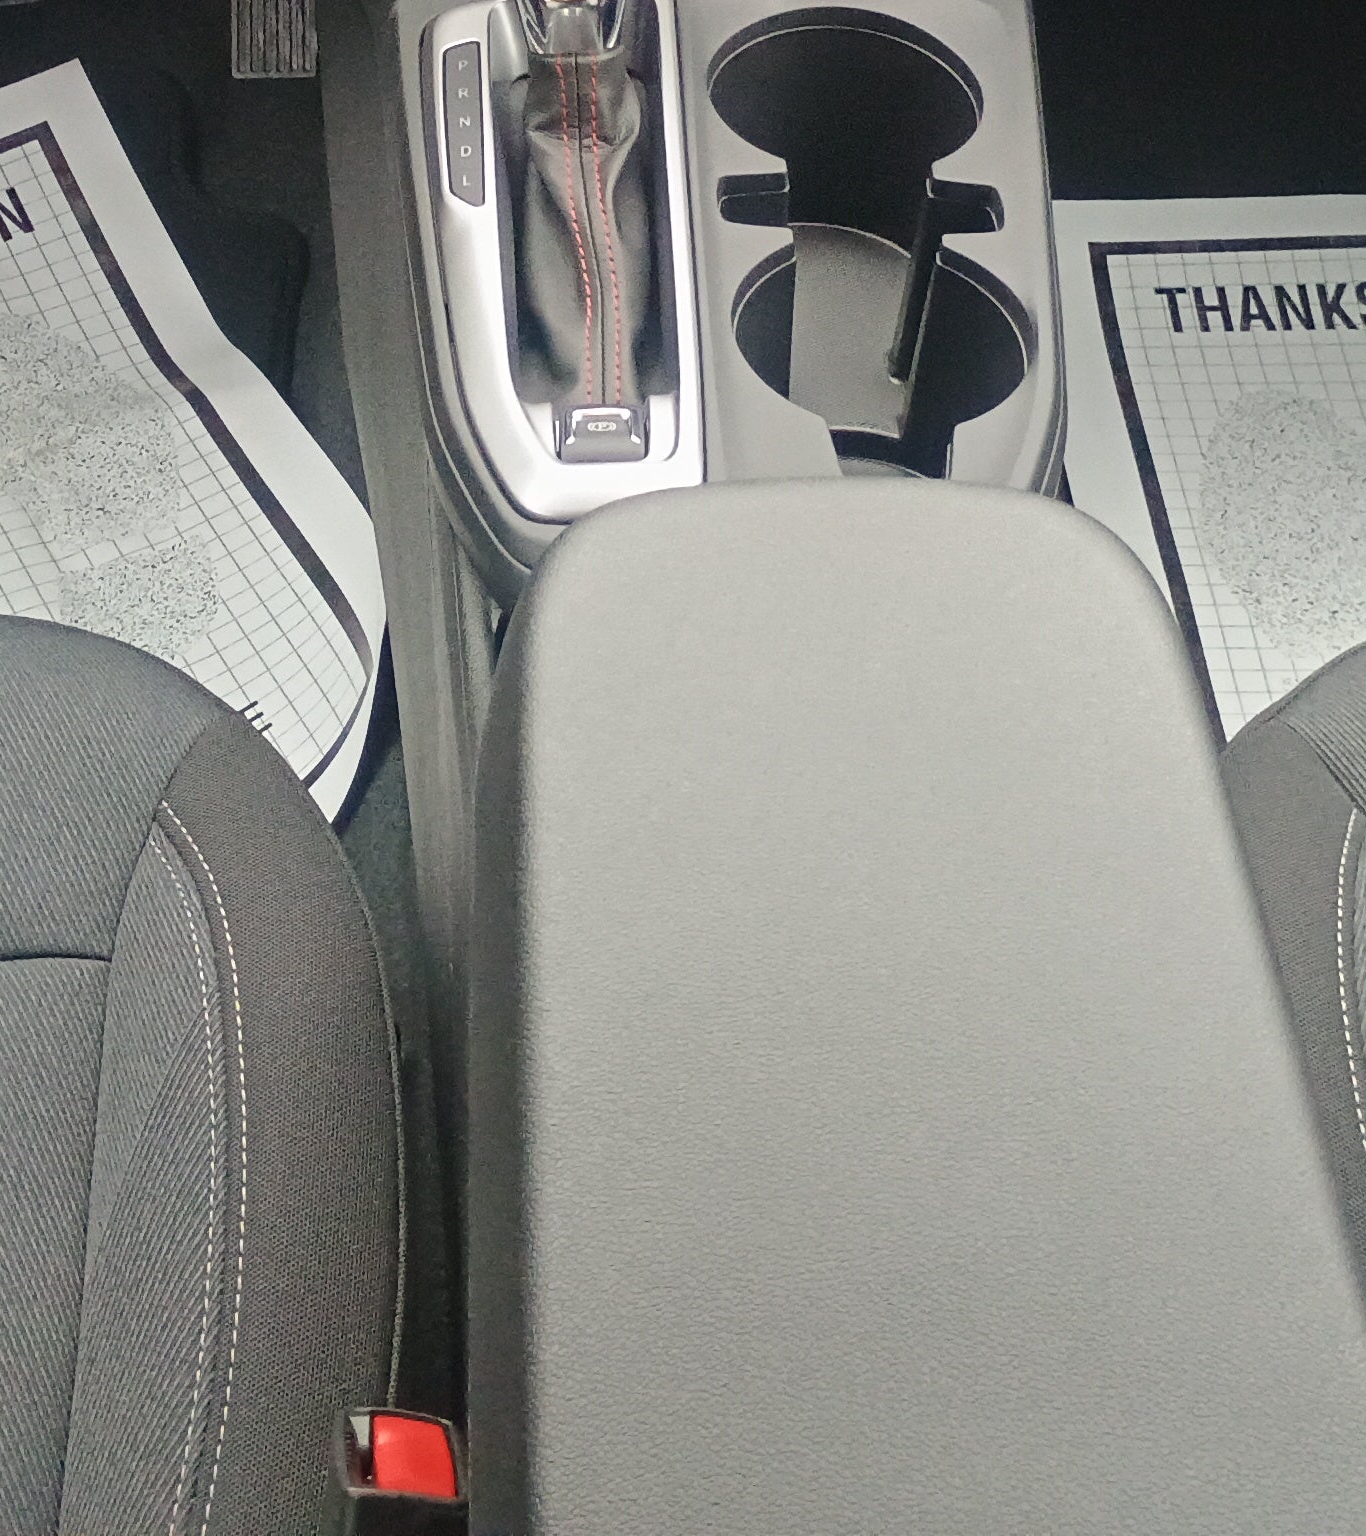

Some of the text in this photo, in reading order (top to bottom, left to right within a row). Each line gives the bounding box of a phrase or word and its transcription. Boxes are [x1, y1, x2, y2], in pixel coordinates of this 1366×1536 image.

[458, 60, 468, 71] P
[458, 88, 469, 99] R
[459, 116, 471, 128] N
[460, 146, 472, 158] D
[462, 174, 471, 187] L
